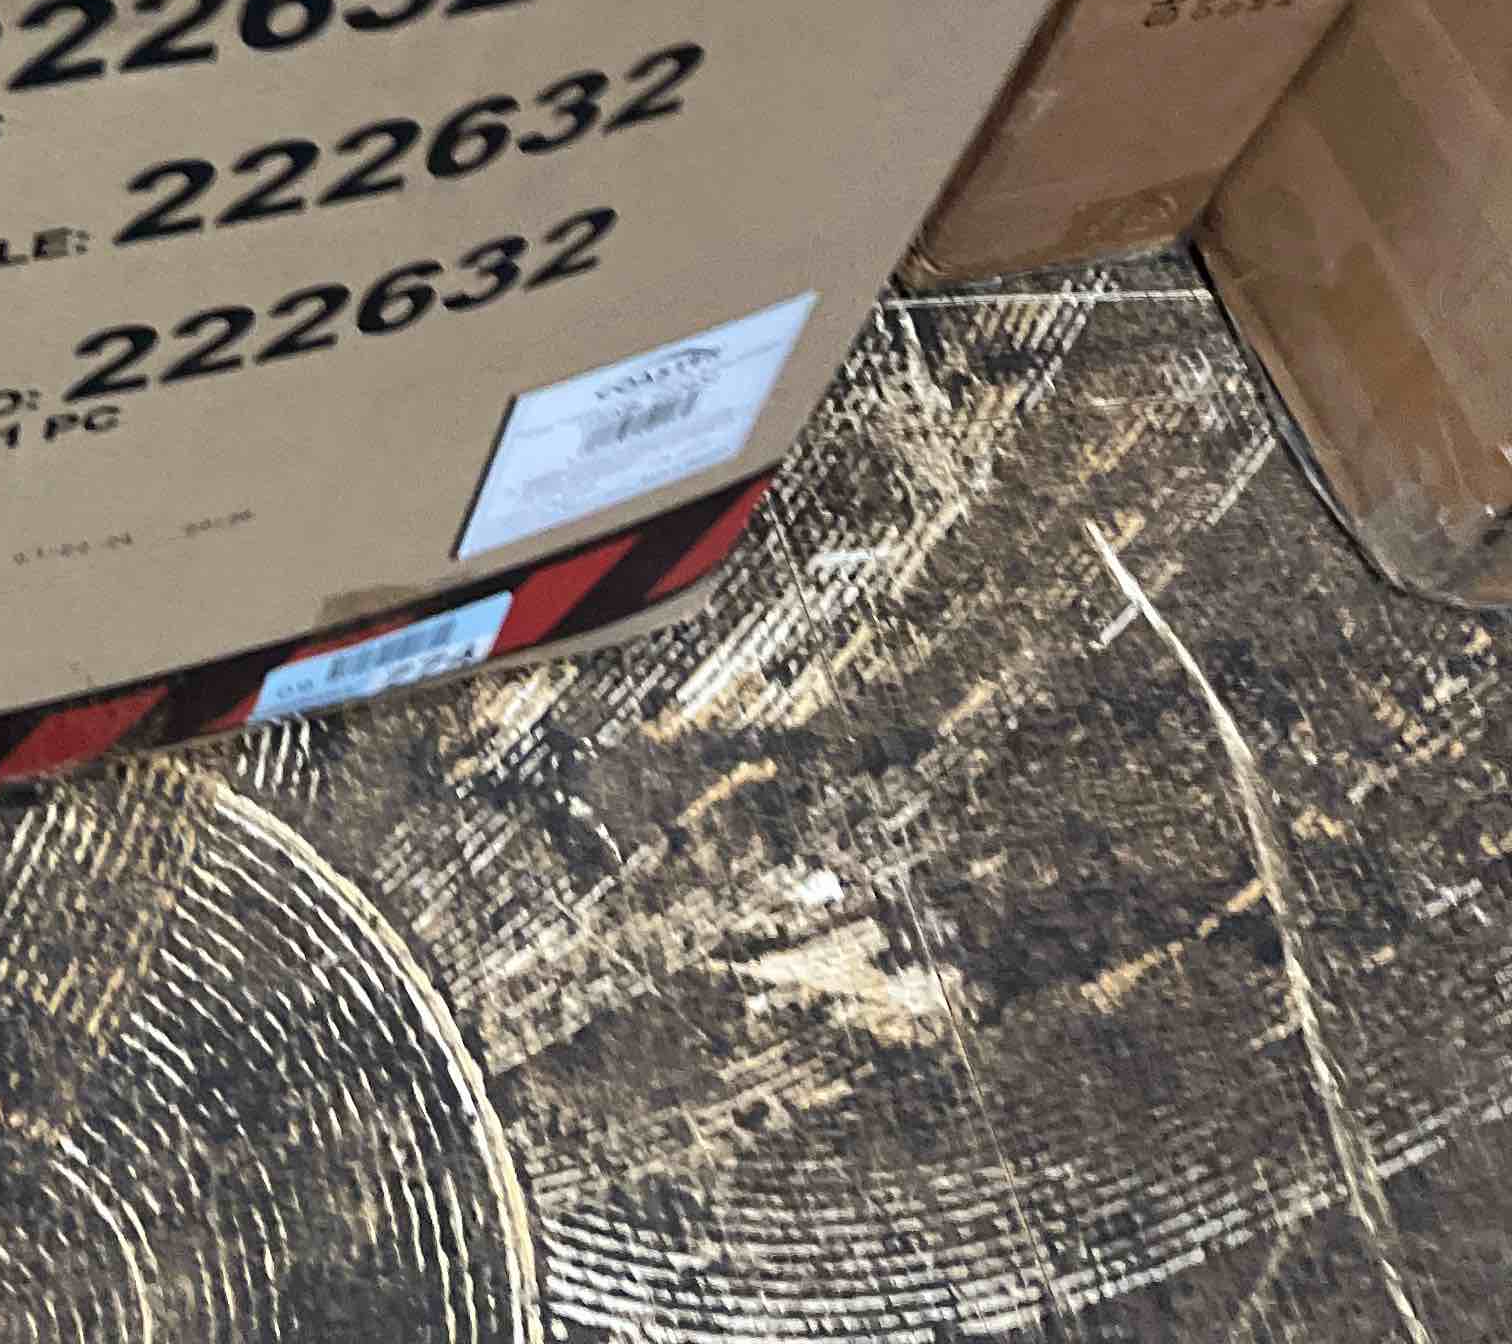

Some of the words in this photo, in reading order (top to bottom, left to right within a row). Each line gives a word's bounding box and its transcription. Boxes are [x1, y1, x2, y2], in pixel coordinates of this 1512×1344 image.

[113, 43, 705, 245] 222632
[64, 207, 617, 403] 222632
[43, 404, 120, 443] PC
